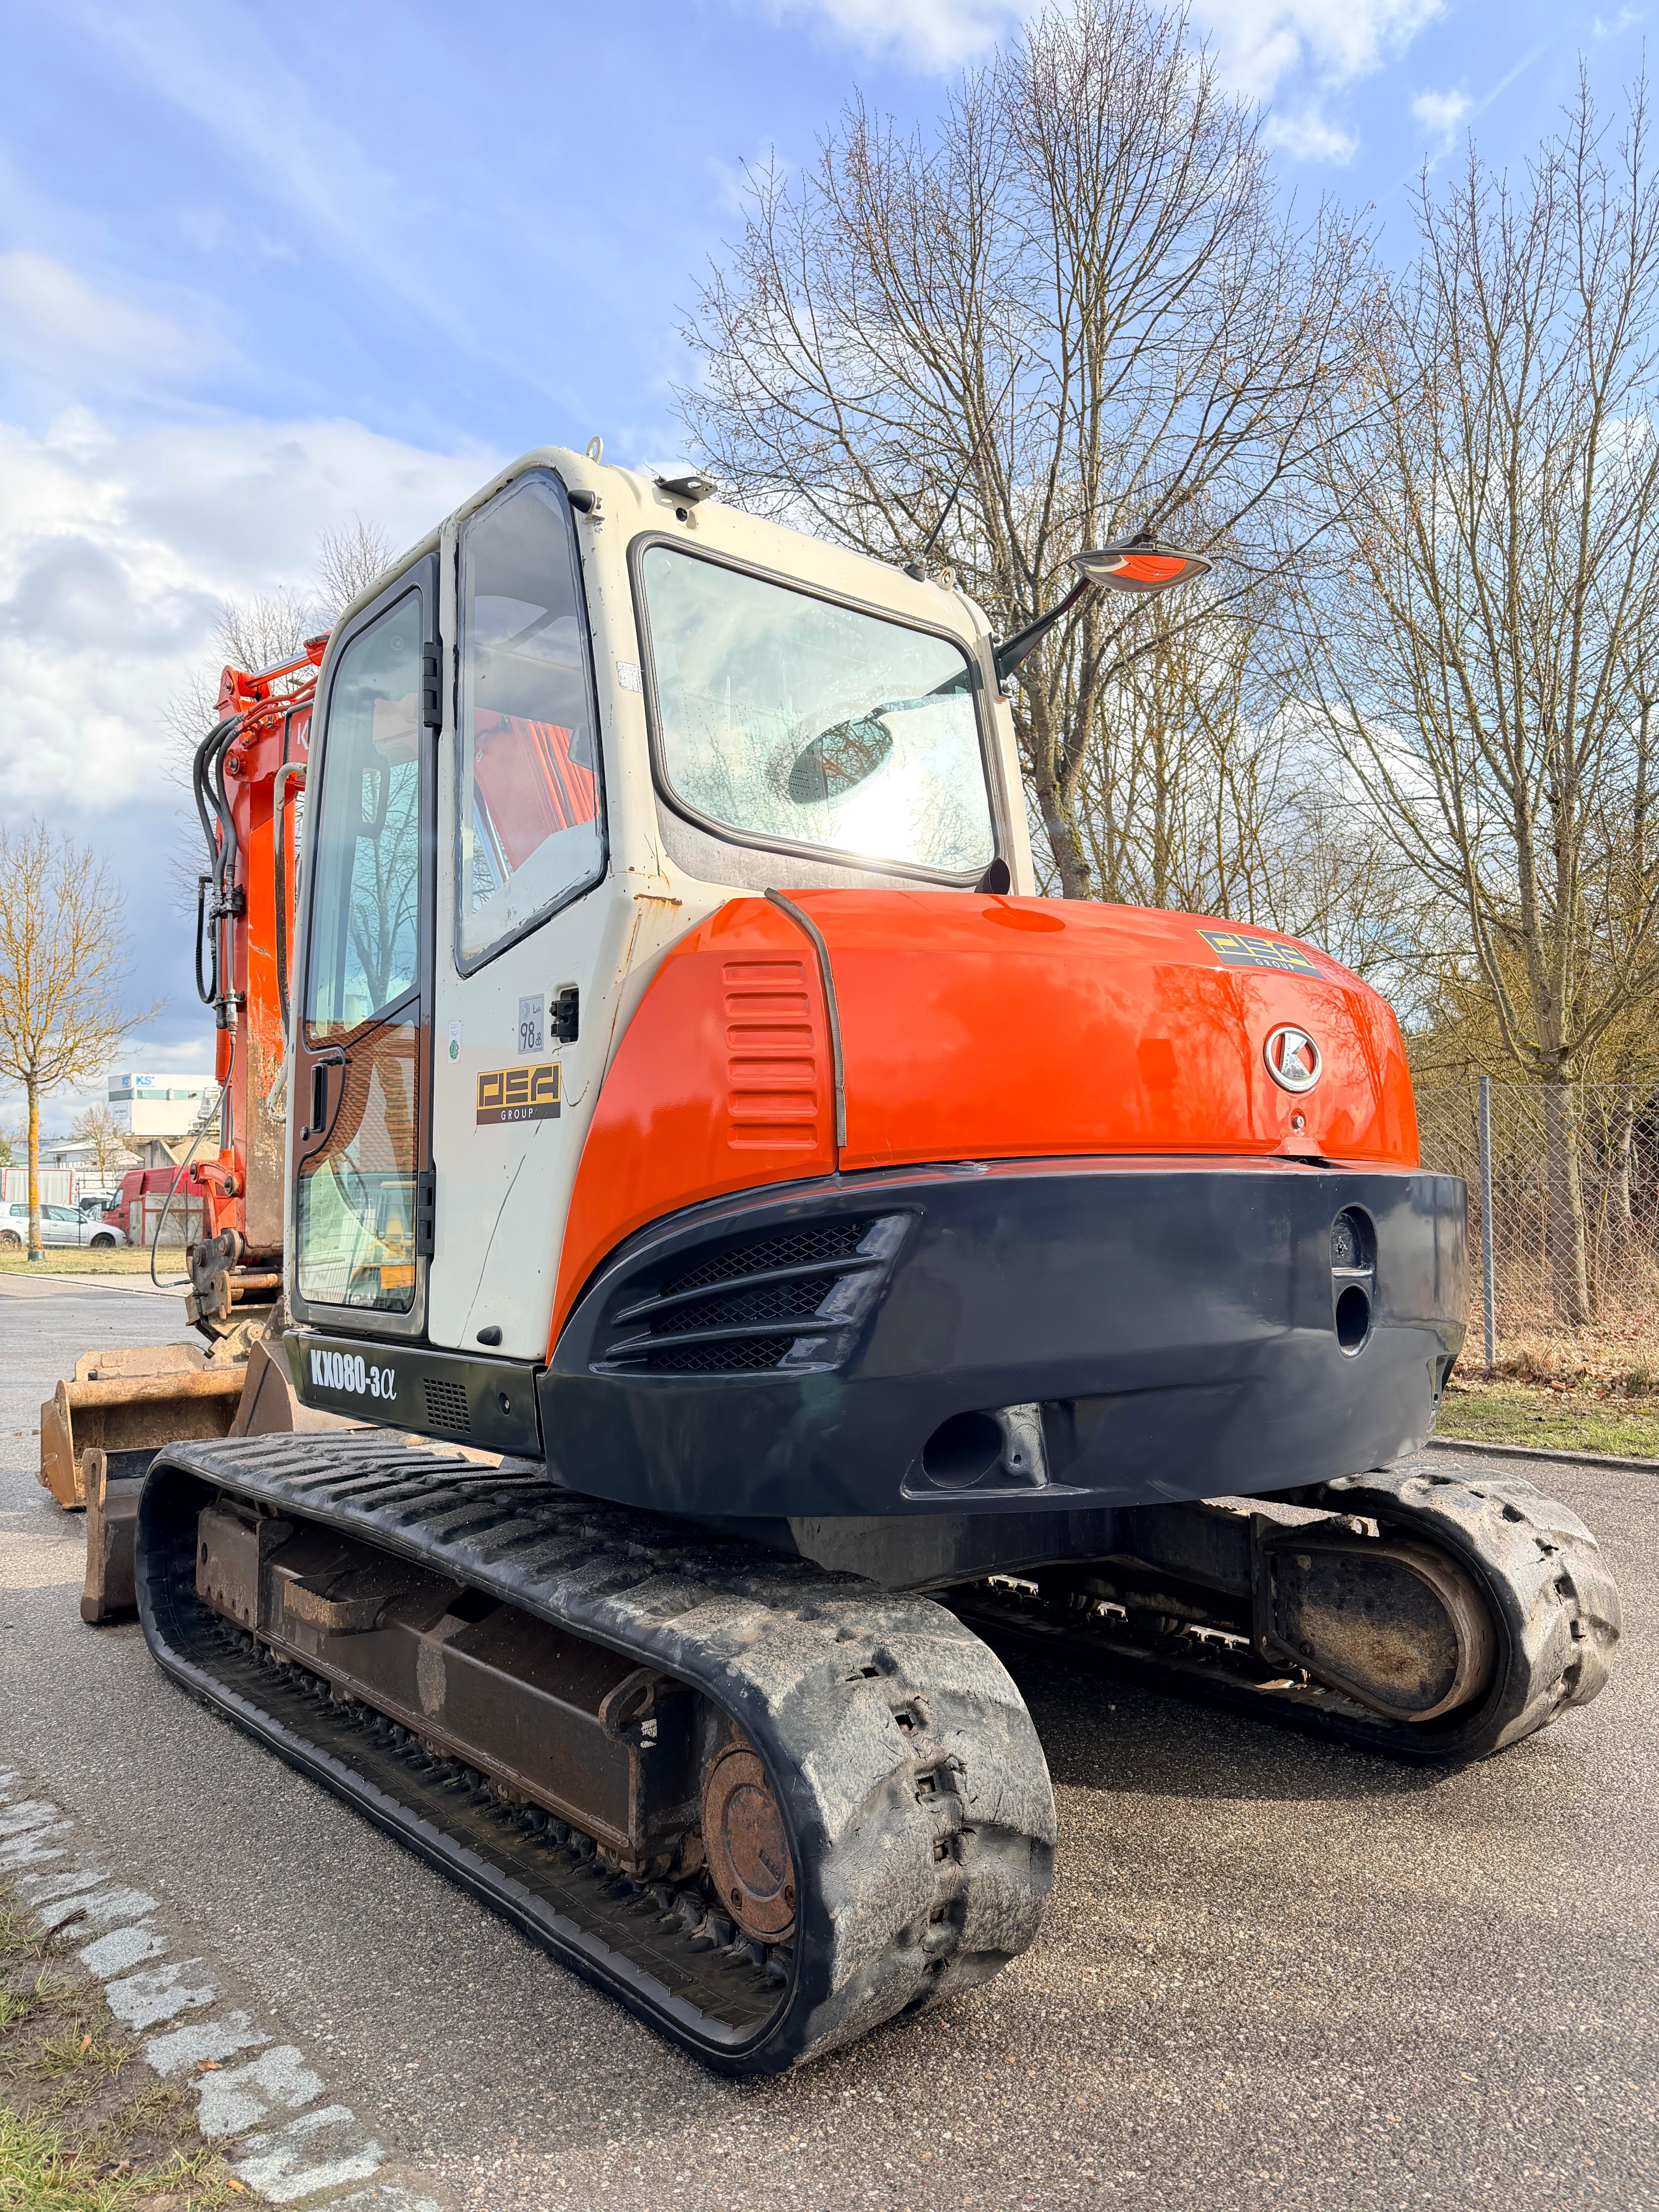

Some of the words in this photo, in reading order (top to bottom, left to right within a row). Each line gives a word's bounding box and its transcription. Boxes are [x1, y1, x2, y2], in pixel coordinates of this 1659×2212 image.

[1255, 958, 1295, 971] GROUP
[521, 1021, 534, 1049] 98
[535, 1032, 542, 1046] dB
[501, 1108, 533, 1120] GROUP
